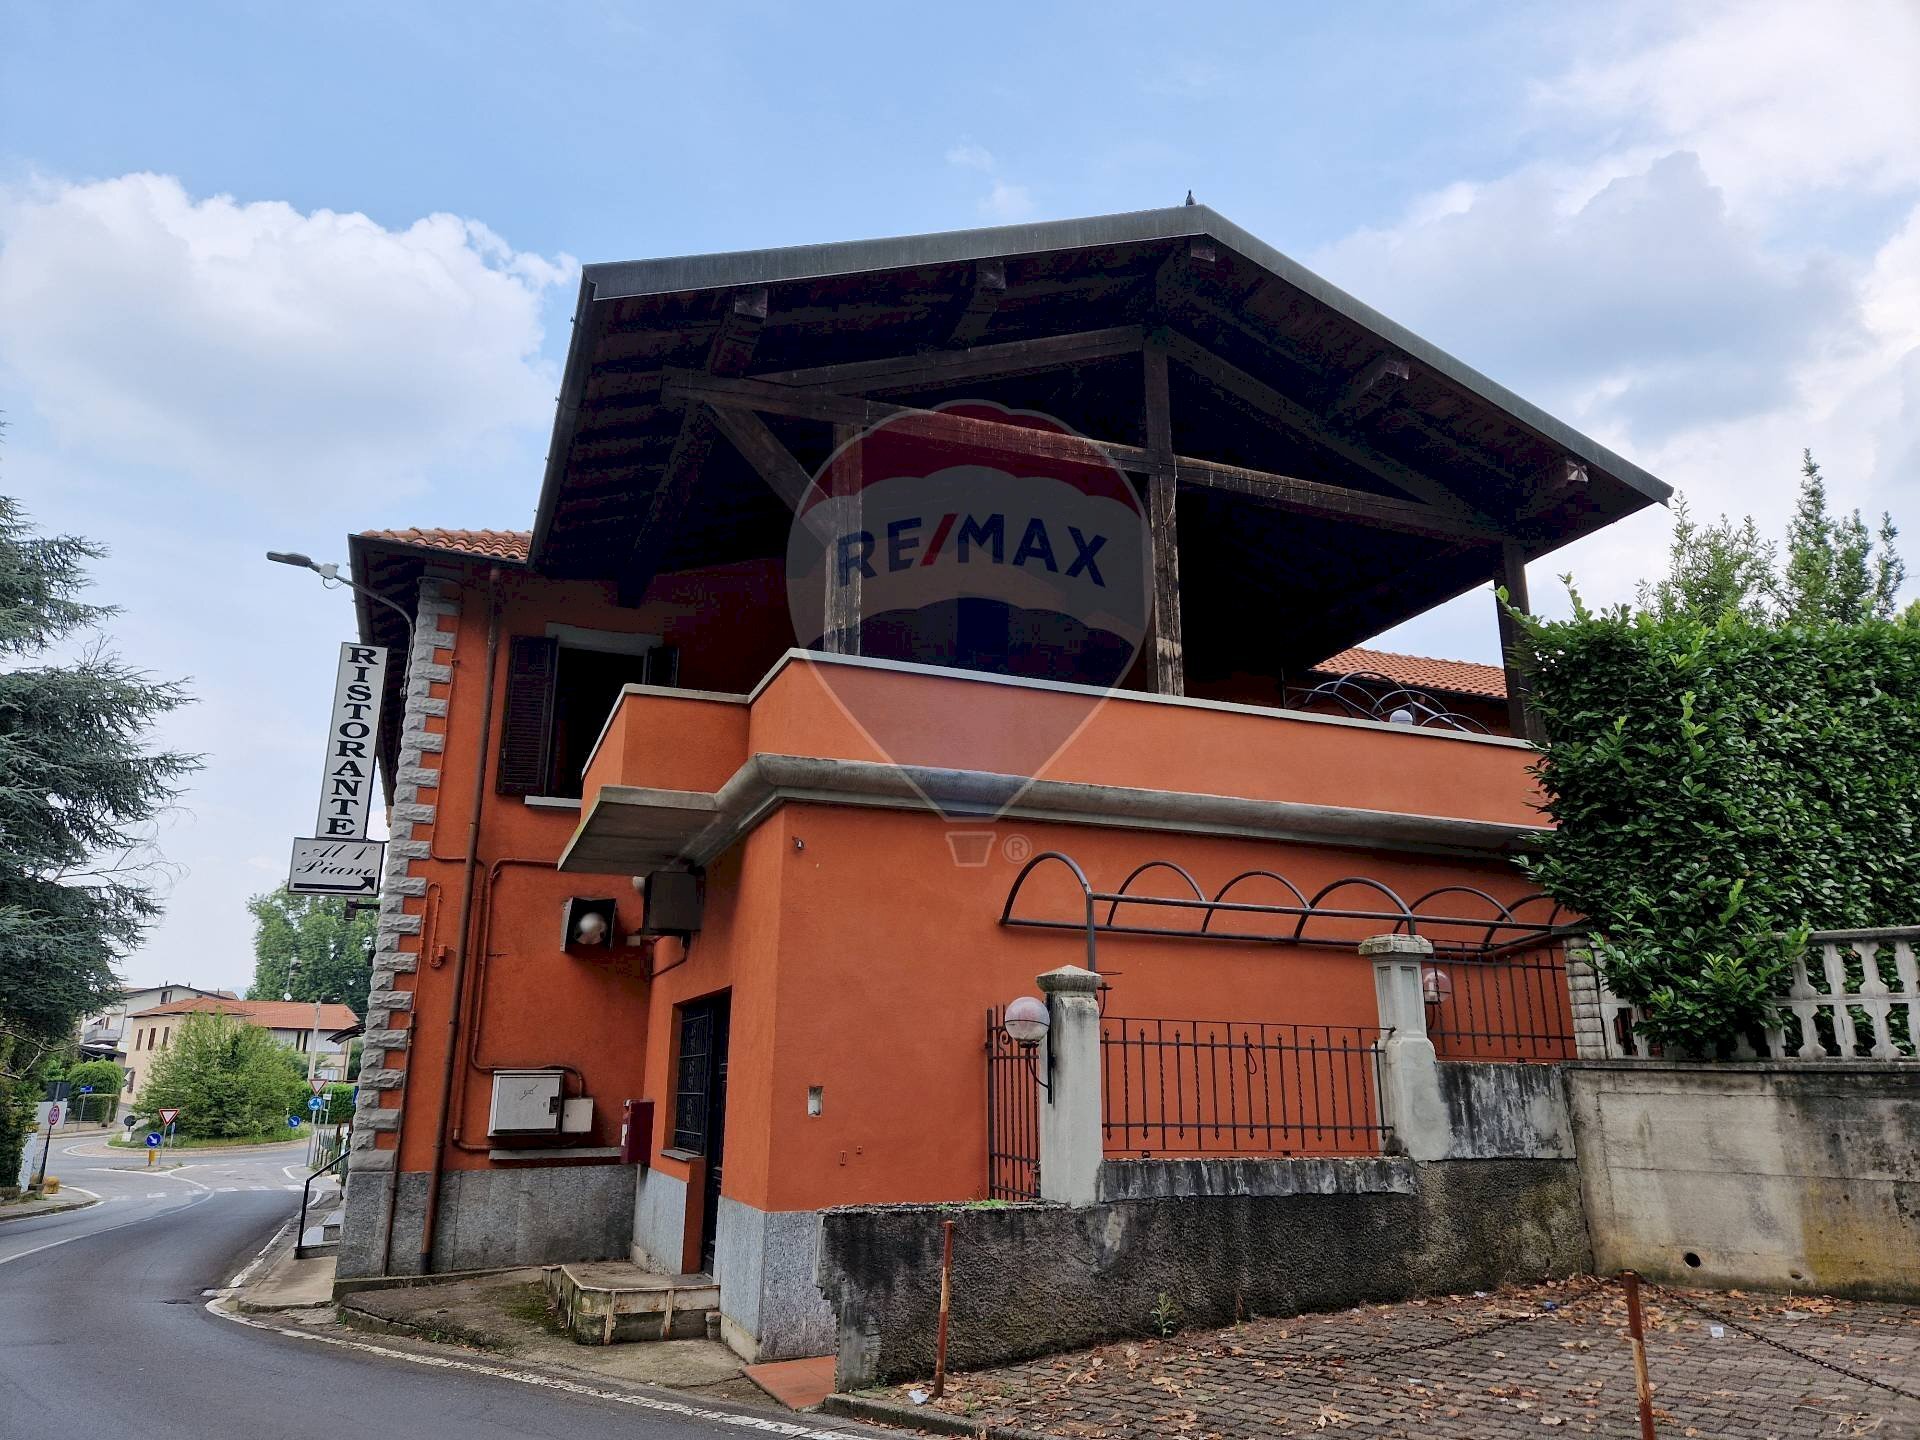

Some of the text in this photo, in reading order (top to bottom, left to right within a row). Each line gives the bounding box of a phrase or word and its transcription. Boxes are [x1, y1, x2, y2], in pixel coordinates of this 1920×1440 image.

[325, 646, 379, 836] RISTORANTE
[301, 843, 347, 858] Al
[295, 860, 375, 876] Piano
